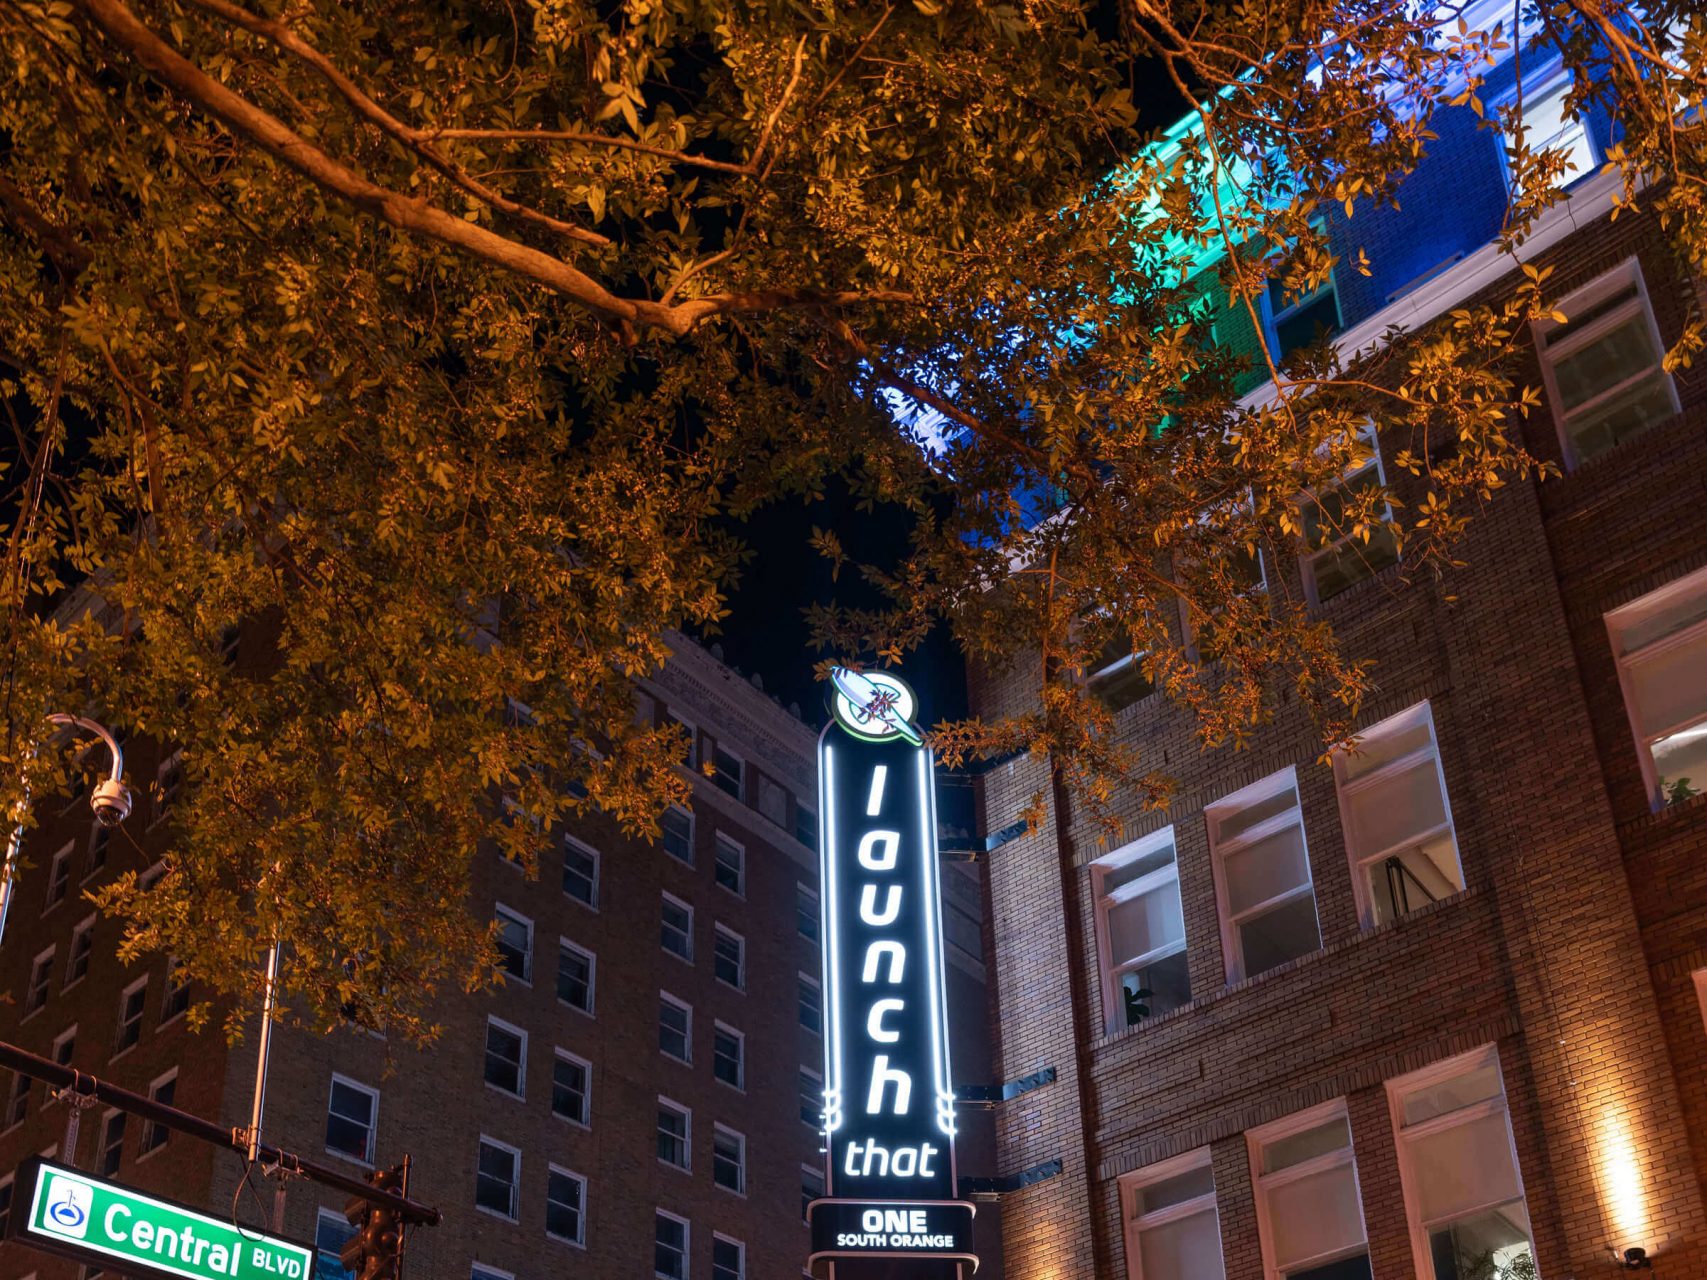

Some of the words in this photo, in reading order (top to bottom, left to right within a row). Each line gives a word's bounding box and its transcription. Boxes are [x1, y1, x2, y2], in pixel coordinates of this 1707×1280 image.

[844, 1137, 938, 1178] that
[862, 1209, 928, 1233] ONE
[104, 1203, 242, 1277] Central
[252, 1246, 301, 1279] BLVD
[837, 1233, 887, 1247] SOUTH
[890, 1234, 954, 1248] ORANGE
